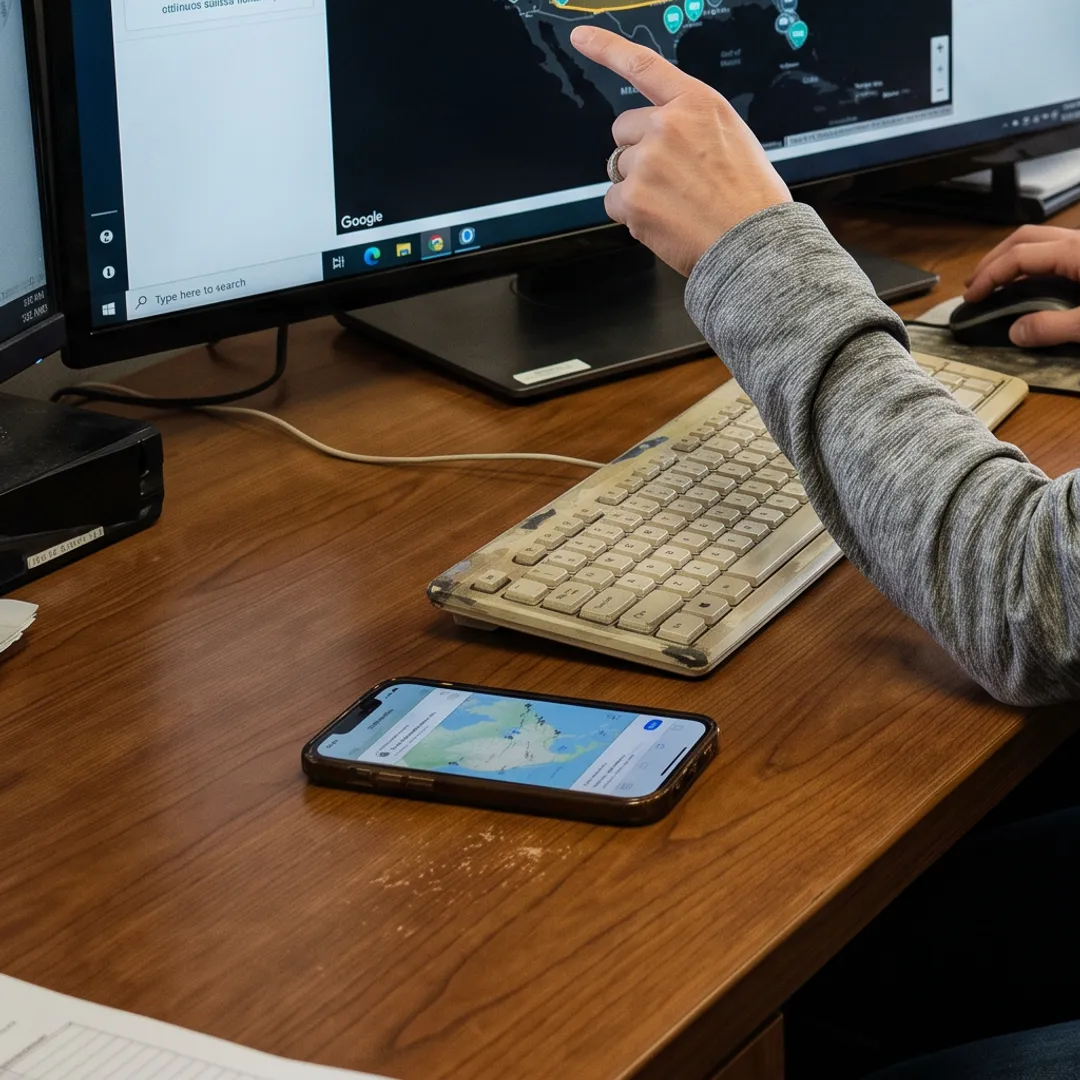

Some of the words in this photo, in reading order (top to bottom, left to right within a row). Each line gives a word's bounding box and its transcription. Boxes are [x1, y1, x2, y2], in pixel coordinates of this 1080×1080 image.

[340, 210, 384, 229] Google
[155, 293, 178, 306] Type
[180, 289, 201, 300] here
[203, 285, 214, 296] to
